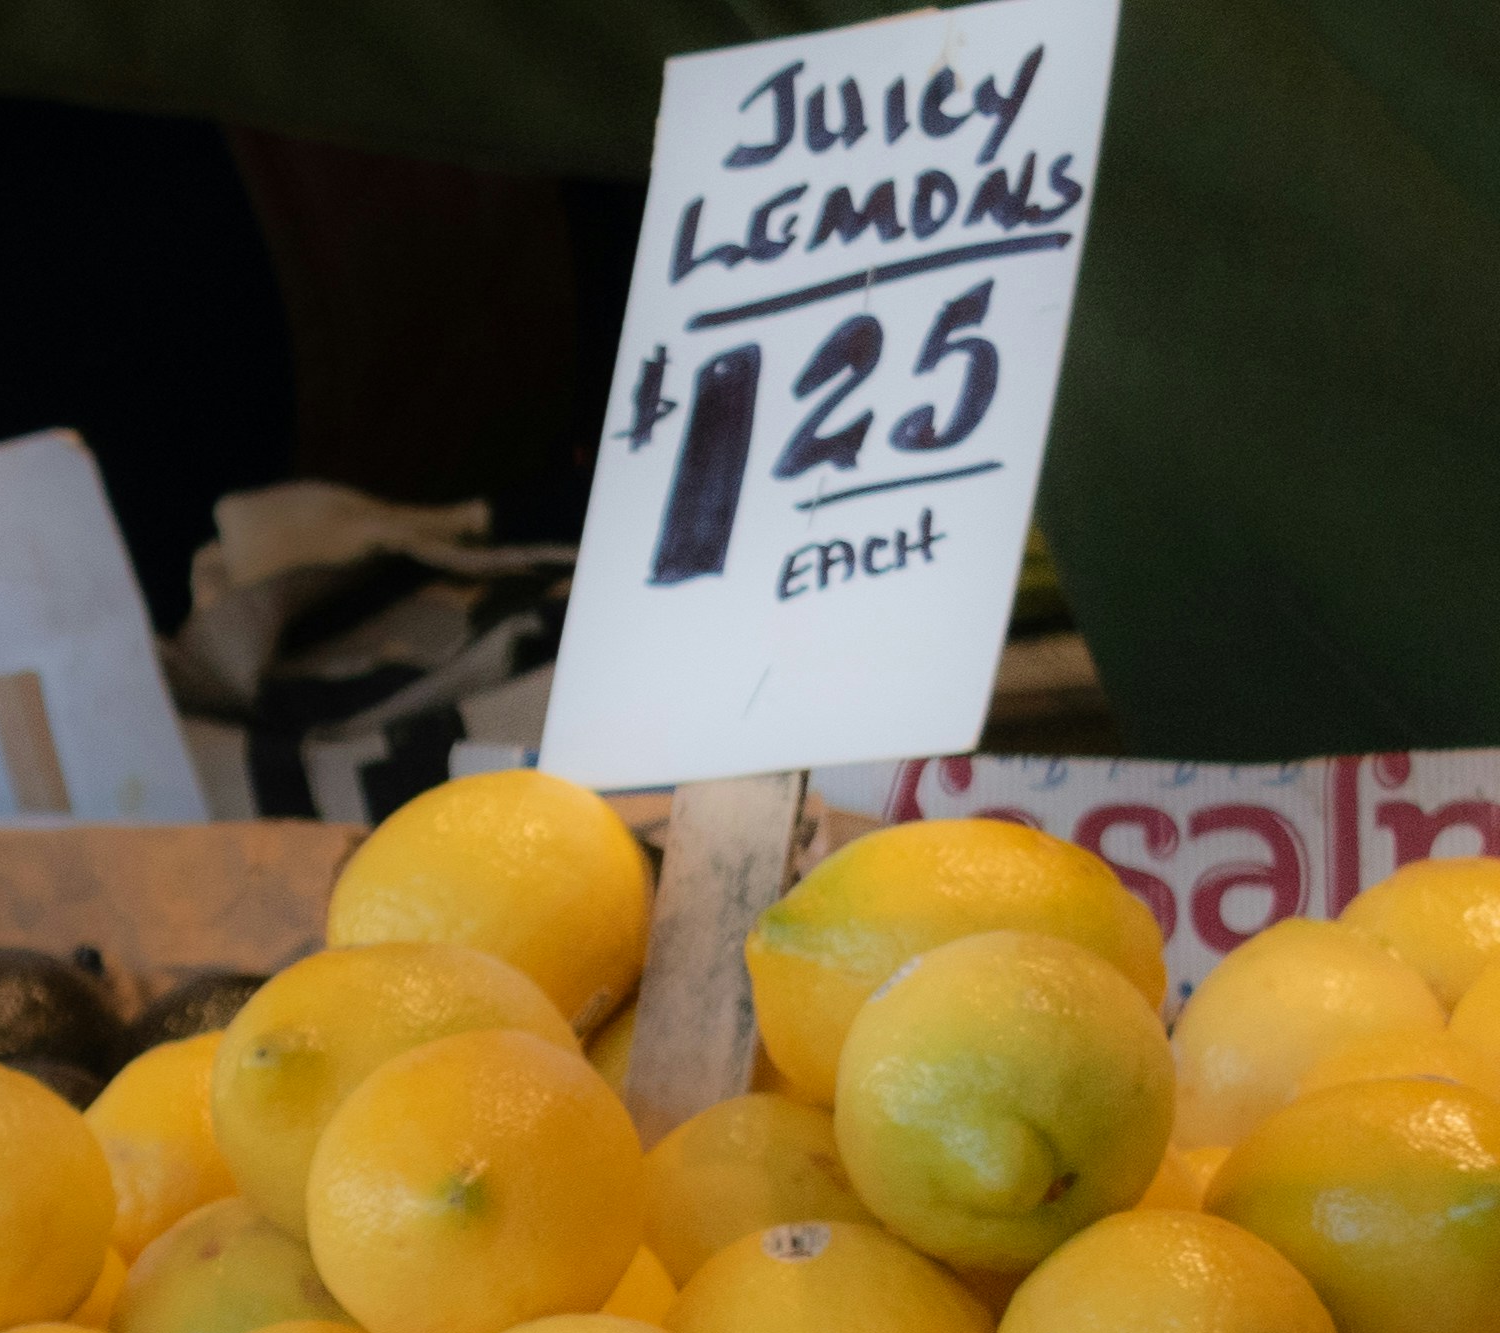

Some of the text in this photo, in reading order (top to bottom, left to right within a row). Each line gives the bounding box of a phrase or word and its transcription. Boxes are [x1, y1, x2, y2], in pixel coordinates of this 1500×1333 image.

[721, 44, 1045, 170] JUICY
[668, 150, 1084, 287] LEMONS
[776, 507, 947, 601] EACH
